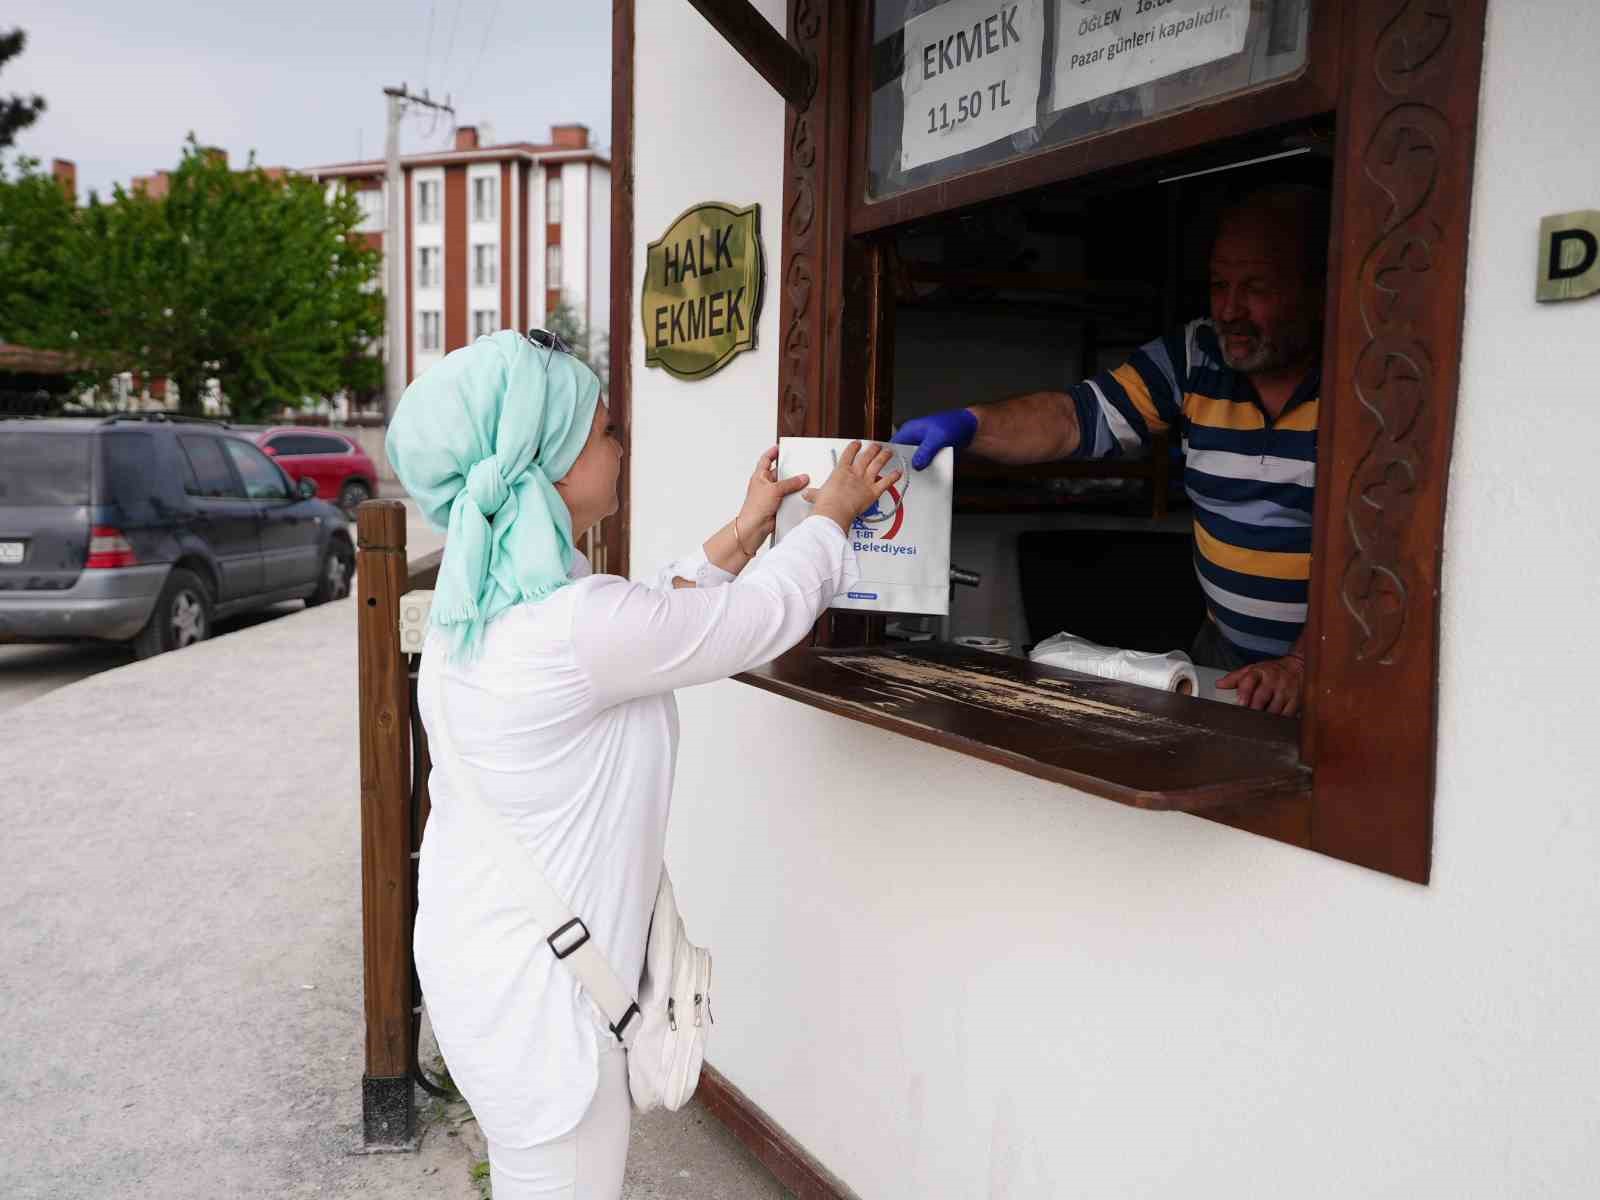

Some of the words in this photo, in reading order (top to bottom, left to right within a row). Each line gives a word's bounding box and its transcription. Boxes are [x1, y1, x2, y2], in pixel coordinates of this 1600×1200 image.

[924, 5, 1020, 80] EKMEK
[1071, 47, 1105, 69] Pazar
[1107, 26, 1156, 61] günleri
[1159, 5, 1230, 39] kapalıdır.
[1078, 8, 1122, 36] ÖĞLEN
[927, 91, 982, 134] 11,50
[988, 80, 1010, 111] TL
[664, 223, 733, 287] HALK
[1548, 228, 1598, 280] D
[655, 286, 746, 348] EKMEK
[853, 542, 917, 556] Belediyesi
